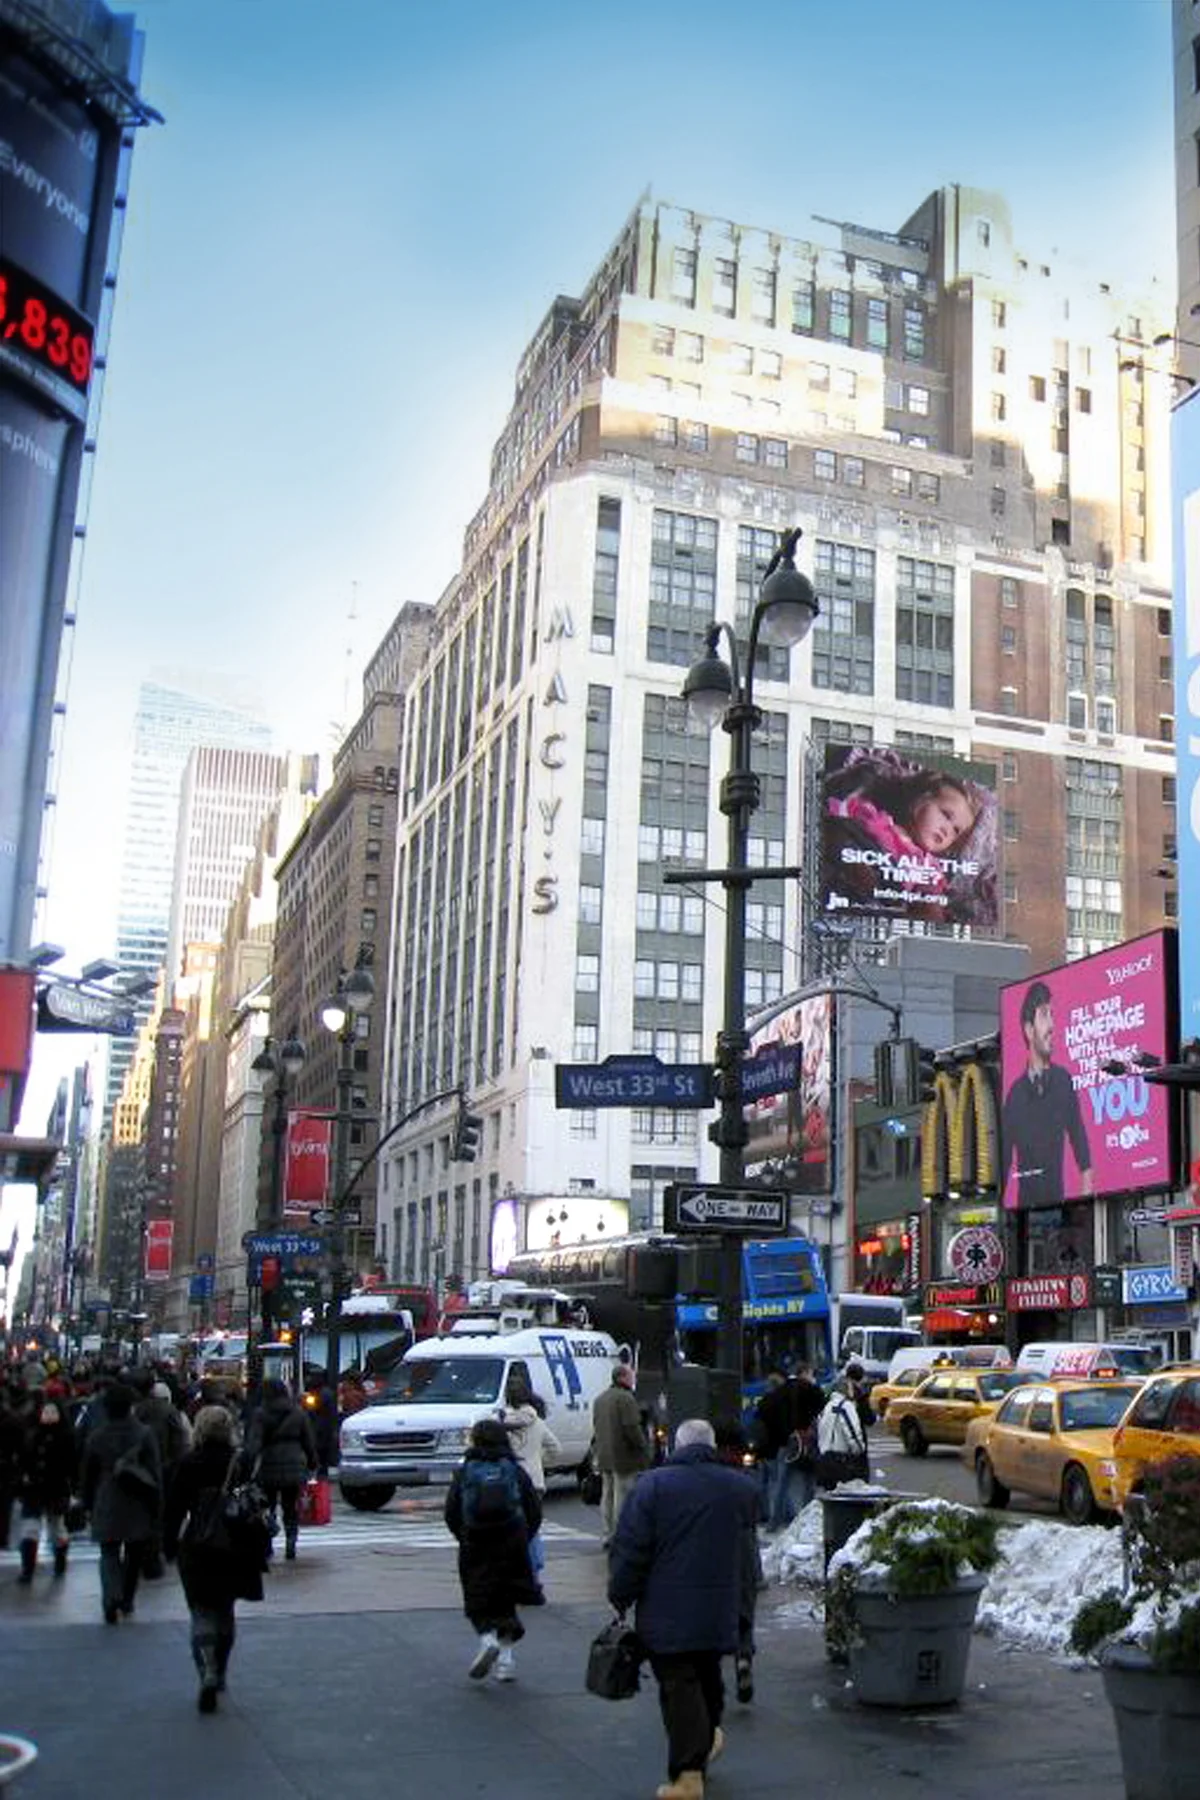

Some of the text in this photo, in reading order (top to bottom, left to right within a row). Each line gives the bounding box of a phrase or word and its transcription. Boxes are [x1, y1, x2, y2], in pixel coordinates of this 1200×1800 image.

[841, 848, 979, 876] SICK ALL THE
[880, 866, 944, 886] TIME?
[1065, 1003, 1145, 1047] HOMEPAGE
[1071, 1007, 1090, 1024] FILL
[570, 1075, 624, 1096] West
[674, 1075, 695, 1096] St
[1089, 1077, 1149, 1125] YOU
[695, 1200, 777, 1220] ONE WAY
